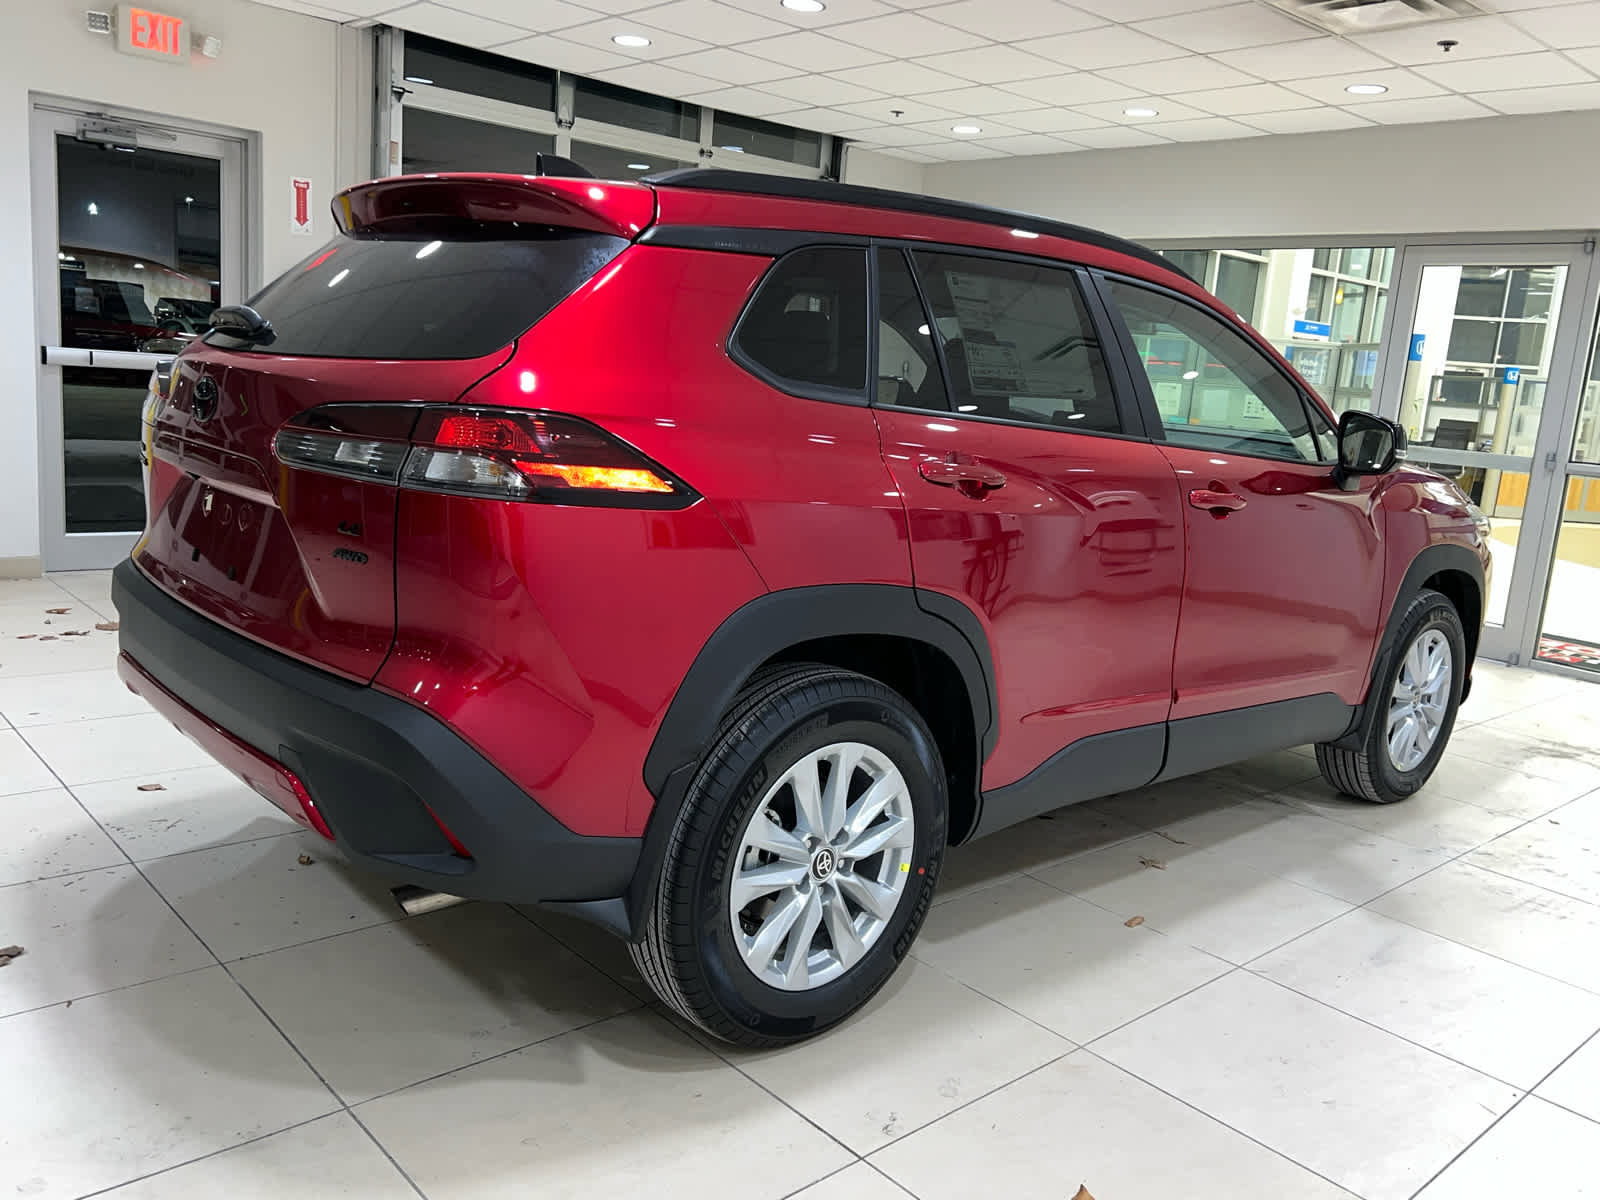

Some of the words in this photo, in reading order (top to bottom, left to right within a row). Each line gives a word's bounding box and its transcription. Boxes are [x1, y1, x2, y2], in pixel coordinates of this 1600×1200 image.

[130, 8, 183, 56] EXIT
[332, 547, 369, 565] AWD
[711, 766, 767, 882] MICHELIN
[894, 857, 938, 956] MICHELIN
